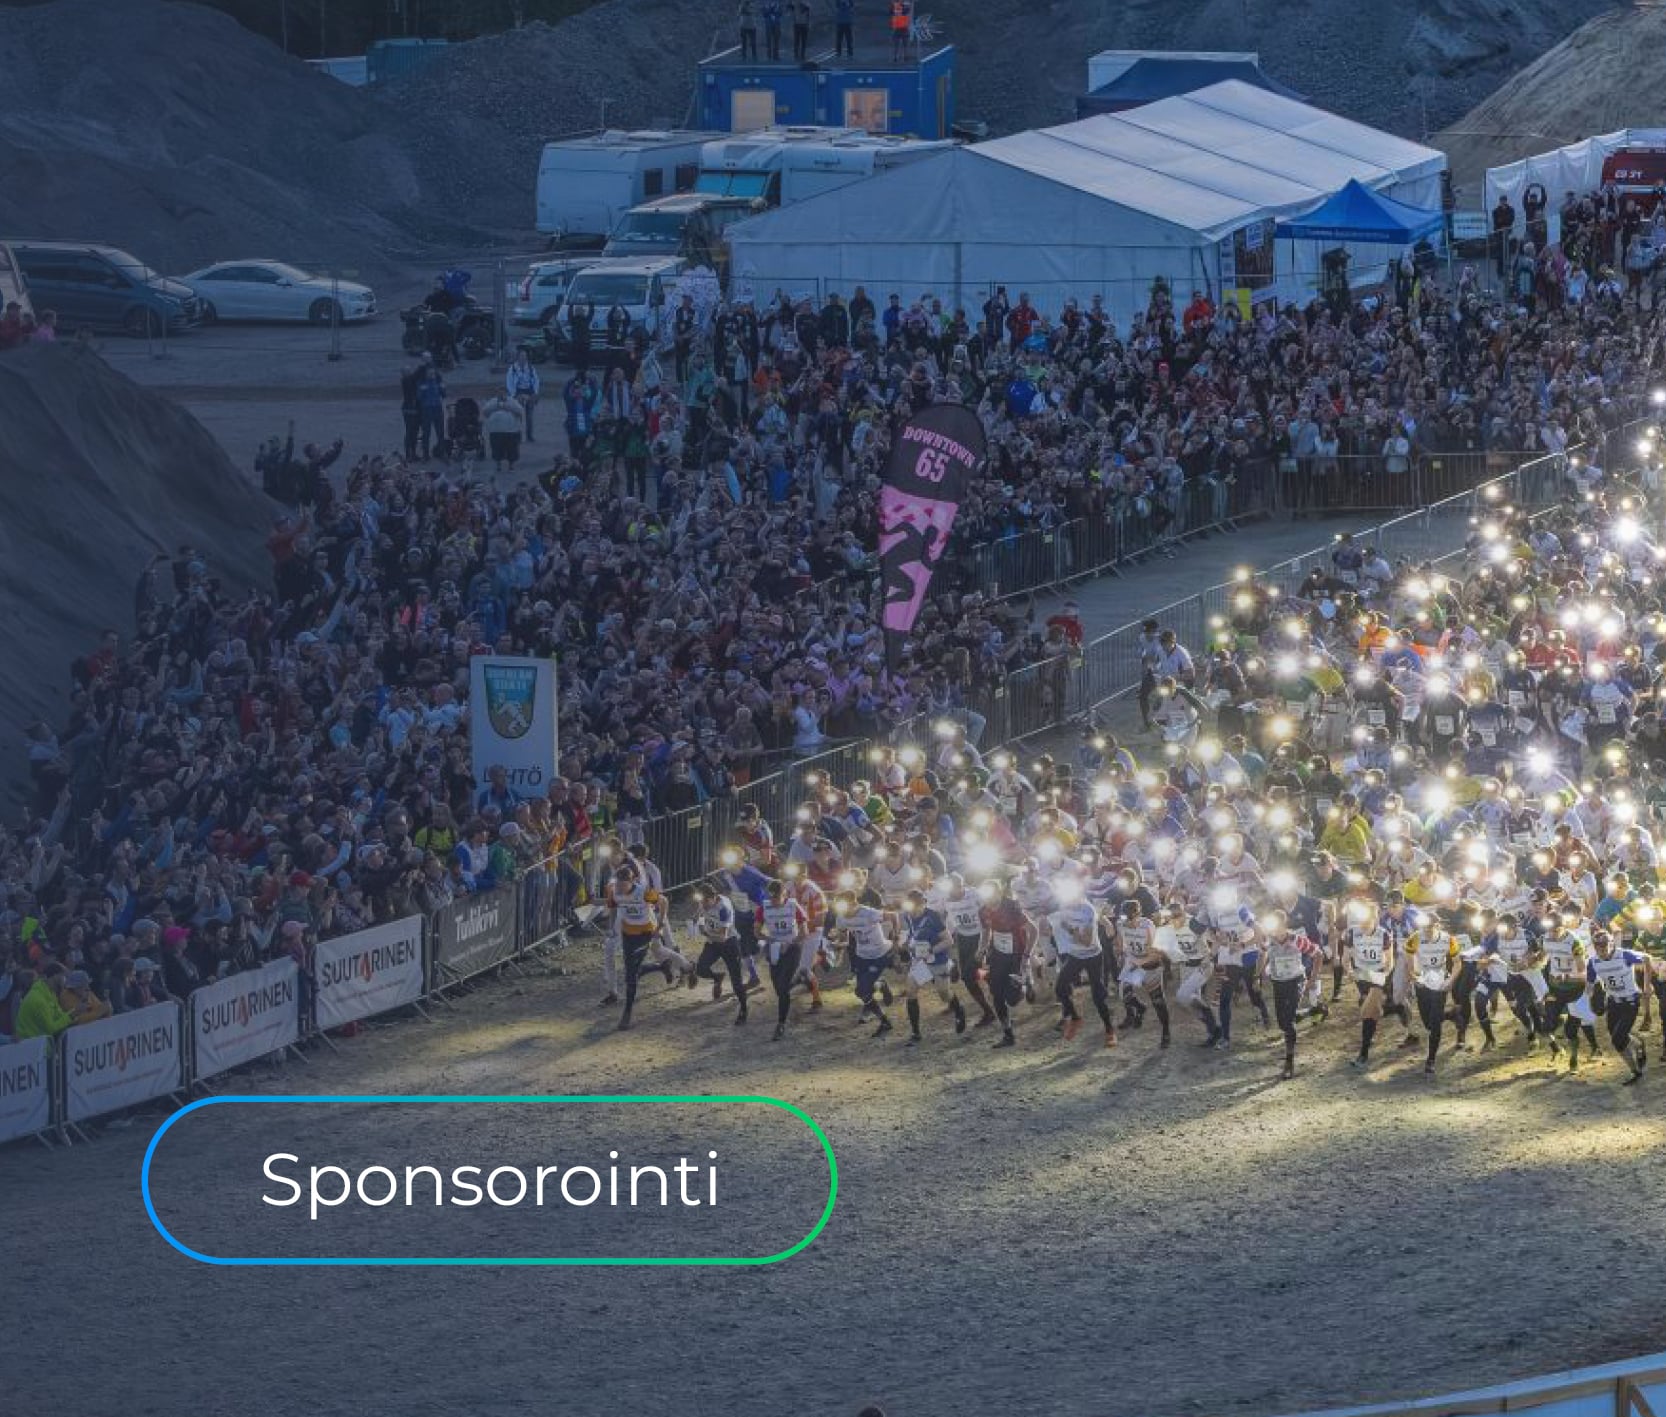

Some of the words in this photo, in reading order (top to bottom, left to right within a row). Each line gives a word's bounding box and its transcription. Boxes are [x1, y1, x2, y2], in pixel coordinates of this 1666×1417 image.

[903, 425, 976, 469] DOWNTOWN
[915, 448, 951, 482] 65
[483, 764, 542, 785] LHTÖ
[455, 900, 499, 942] Tulikivi
[321, 936, 416, 987] SUUTARINEN
[1362, 949, 1377, 960] 10
[202, 980, 293, 1034] SUUTARINEN
[74, 1023, 173, 1077] SUUTARINEN
